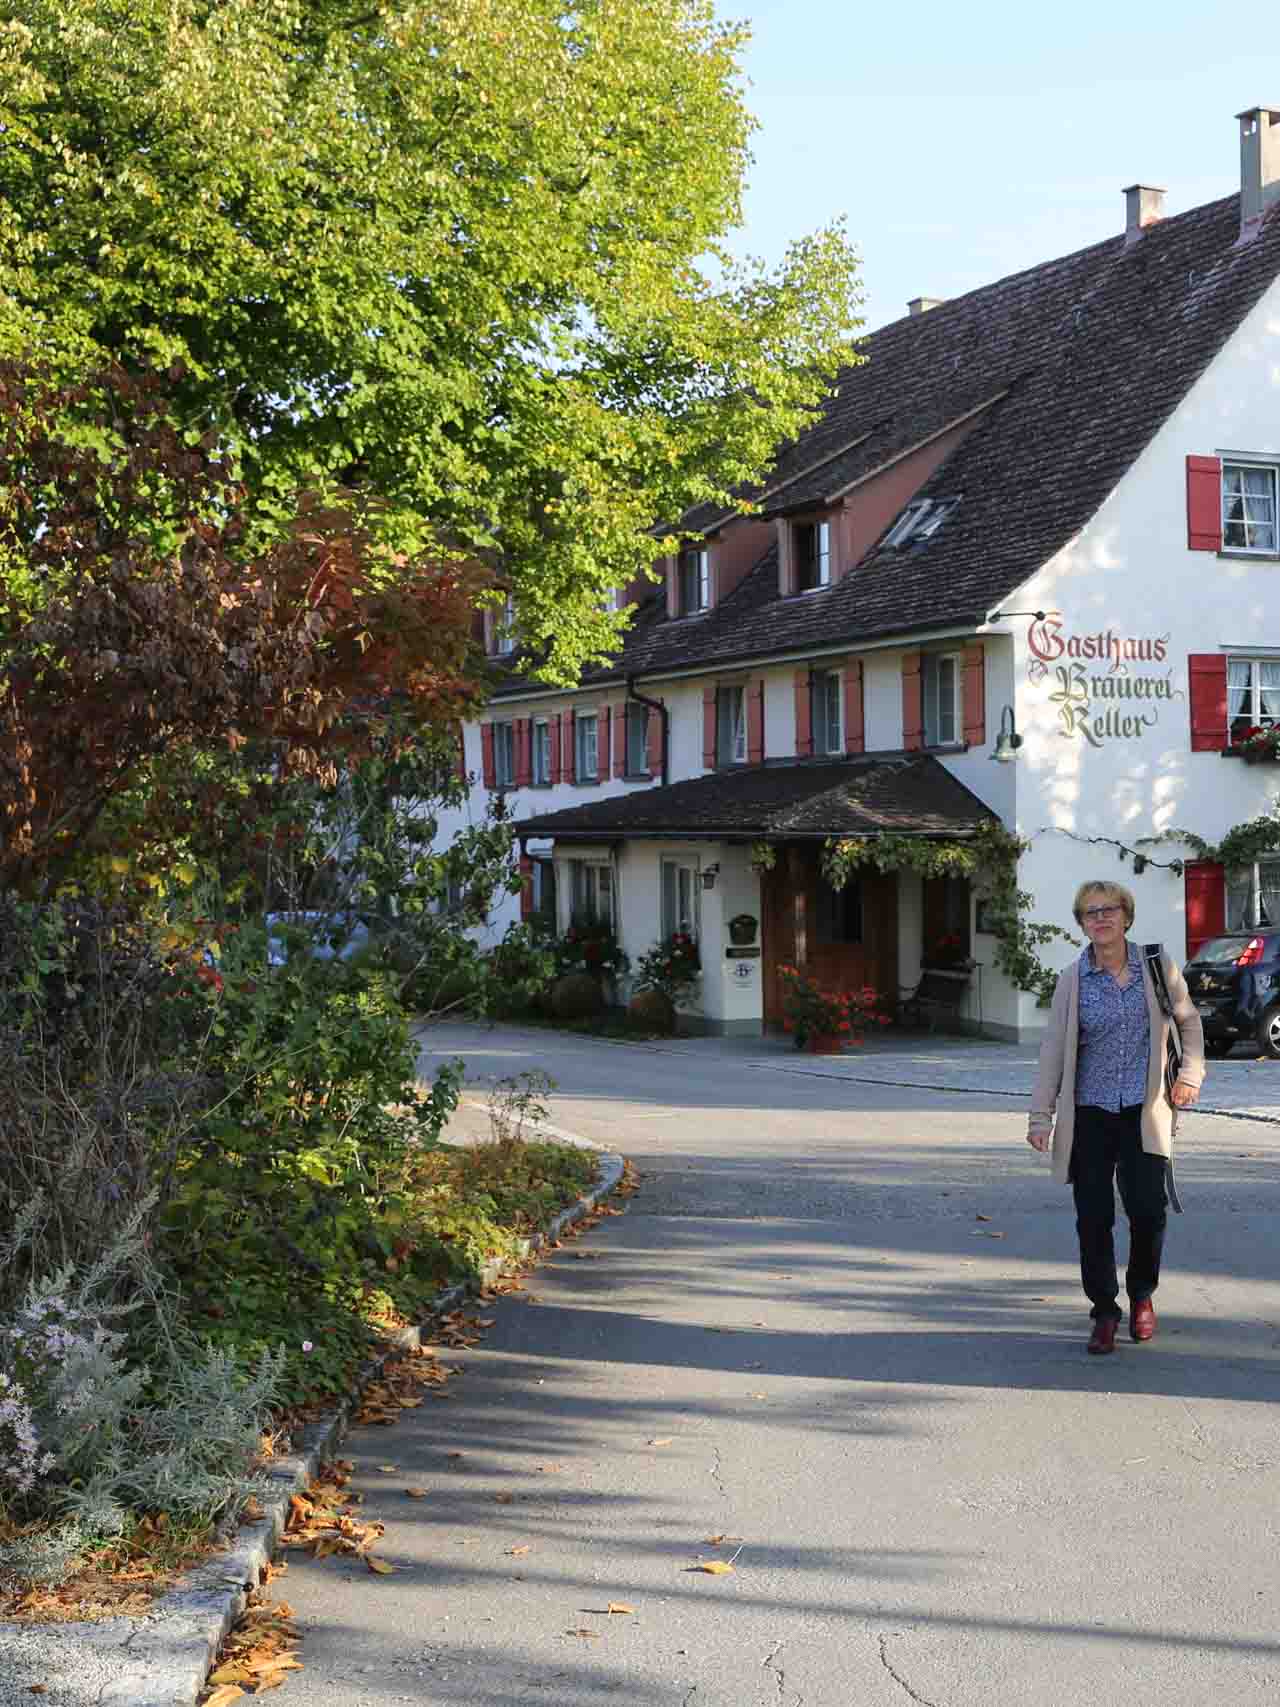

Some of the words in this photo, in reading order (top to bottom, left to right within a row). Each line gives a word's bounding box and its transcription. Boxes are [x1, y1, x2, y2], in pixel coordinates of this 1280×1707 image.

[1027, 616, 1171, 674] Gasthaus
[1048, 661, 1184, 702] Brauerei
[1057, 702, 1158, 748] Keller
